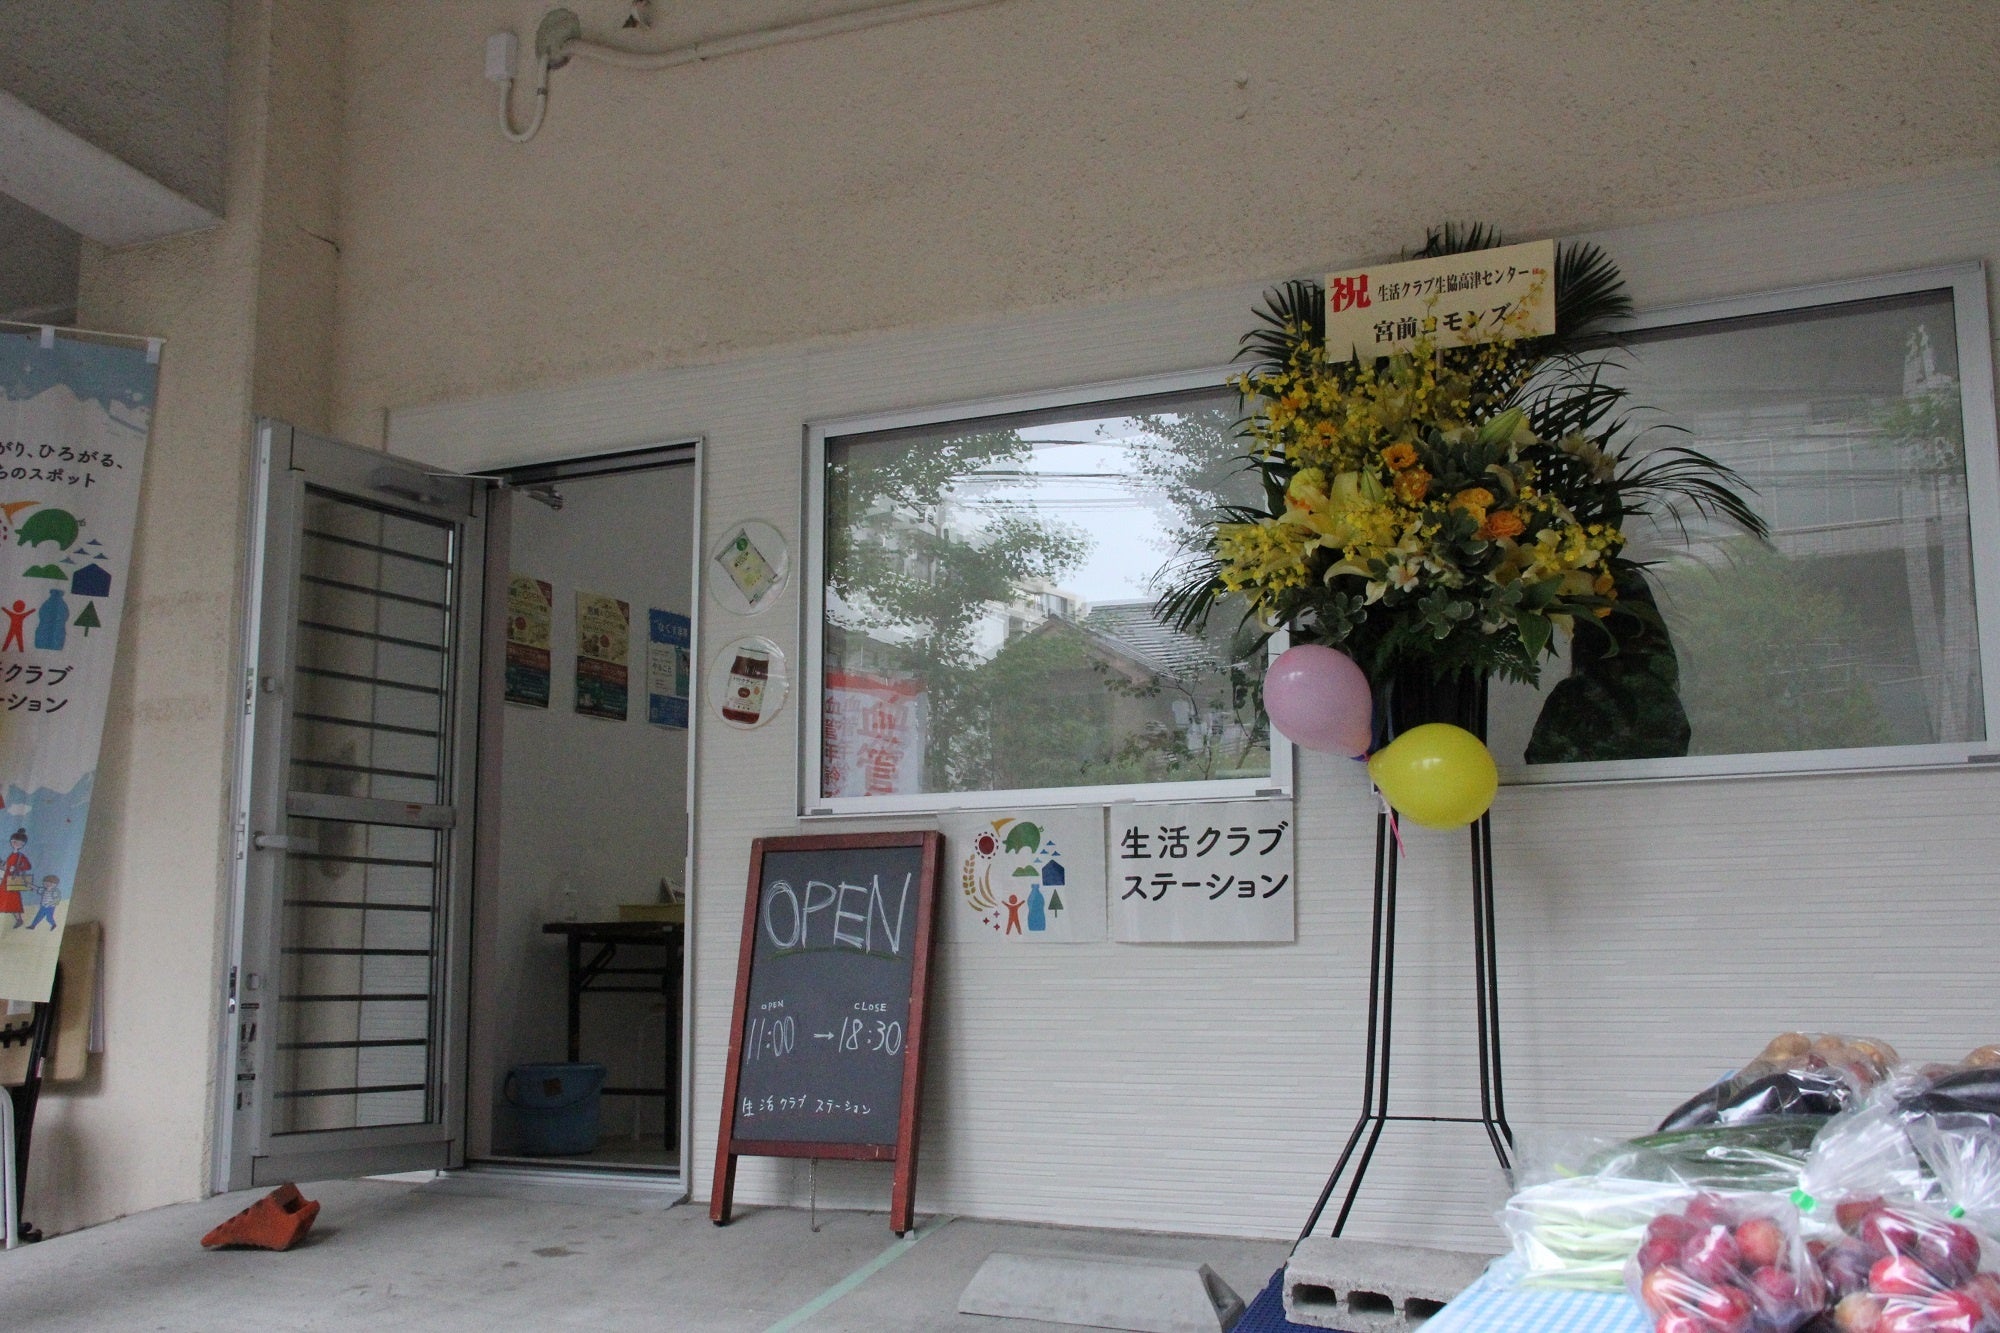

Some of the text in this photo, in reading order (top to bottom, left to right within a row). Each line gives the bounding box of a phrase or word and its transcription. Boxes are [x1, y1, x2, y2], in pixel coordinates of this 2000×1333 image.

[1330, 273, 1372, 313] 祝
[0, 663, 74, 685] クラブ
[1121, 820, 1289, 859] 生活クラブ
[1121, 873, 1289, 901] ステーション
[763, 872, 912, 954] OPEN
[854, 1002, 888, 1012] CLOSE
[747, 1016, 902, 1064] 11:00 18:30
[742, 1094, 807, 1117] 生活クラブ
